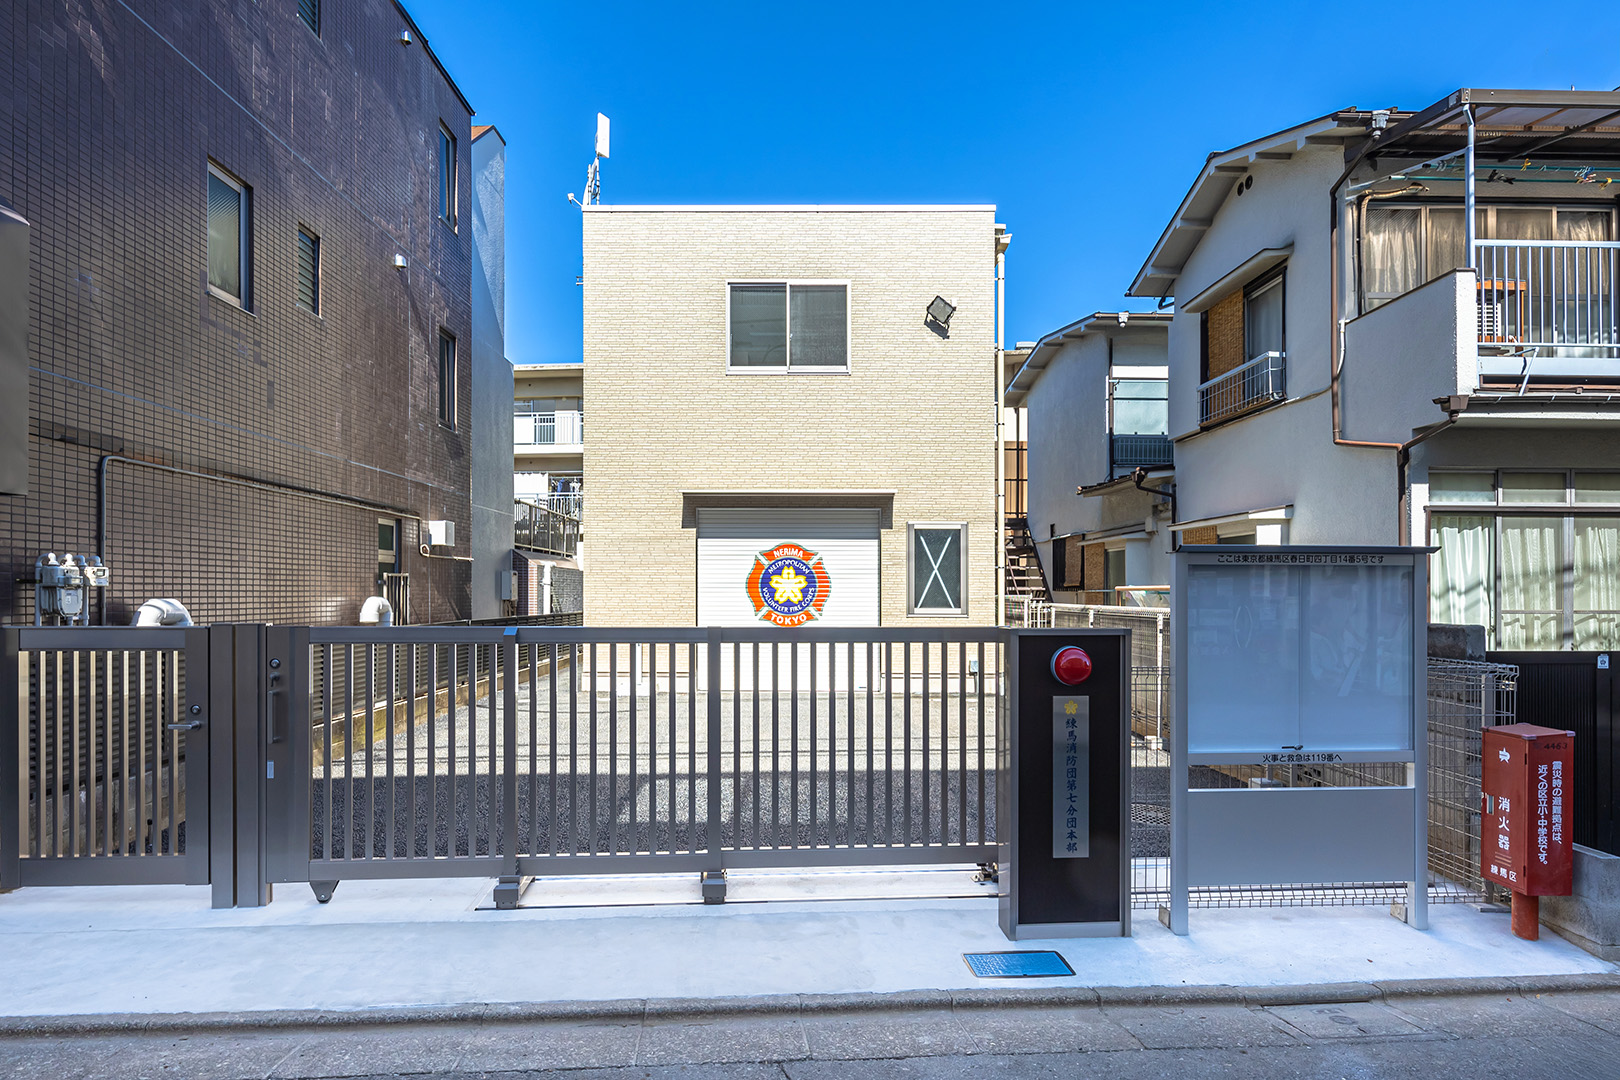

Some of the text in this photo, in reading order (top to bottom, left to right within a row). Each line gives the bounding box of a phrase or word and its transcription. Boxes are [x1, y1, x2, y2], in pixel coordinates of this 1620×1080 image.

[773, 548, 803, 558] NERIMA
[1217, 554, 1384, 564] ここは東京都練馬区春日町四丁目14番5号です
[768, 559, 810, 574] METROPOLITAN
[763, 587, 815, 613] VOLUNTEER FIRE CORPS
[770, 613, 807, 625] TOKYO
[1262, 753, 1342, 763] 火事と救急は119番へ
[1065, 717, 1078, 854] 練馬消防団第七分団本部
[1552, 760, 1563, 845] 震災時の避難拠点は、
[1498, 796, 1511, 851] 消火器
[1490, 863, 1517, 883] 練馬区
